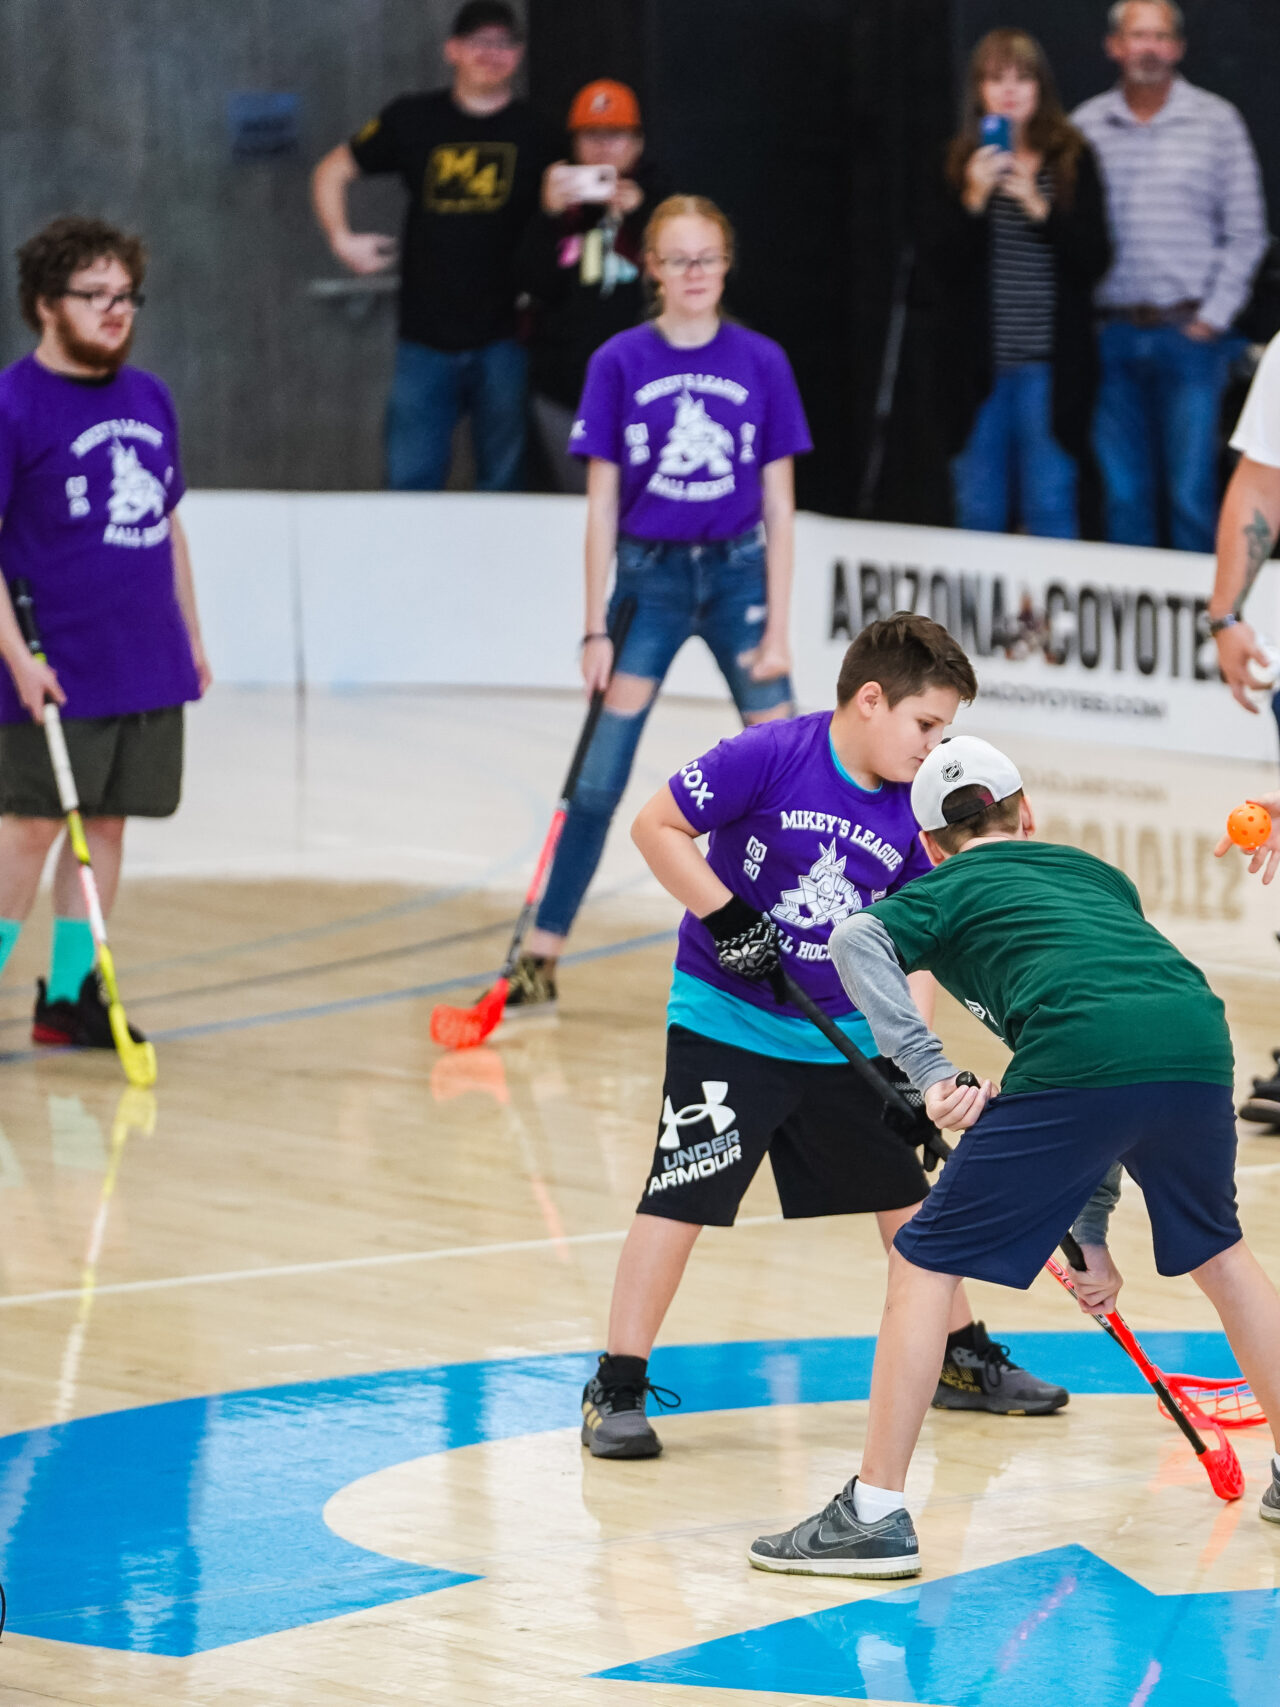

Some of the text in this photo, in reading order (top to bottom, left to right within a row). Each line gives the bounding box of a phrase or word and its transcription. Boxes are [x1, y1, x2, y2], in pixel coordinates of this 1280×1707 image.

[1044, 583, 1217, 681] COYOTE
[780, 810, 904, 872] MIKEY'S LEAGUE
[743, 858, 761, 881] 20
[647, 1144, 742, 1196] ARMOUR
[663, 1128, 741, 1171] UNDER
